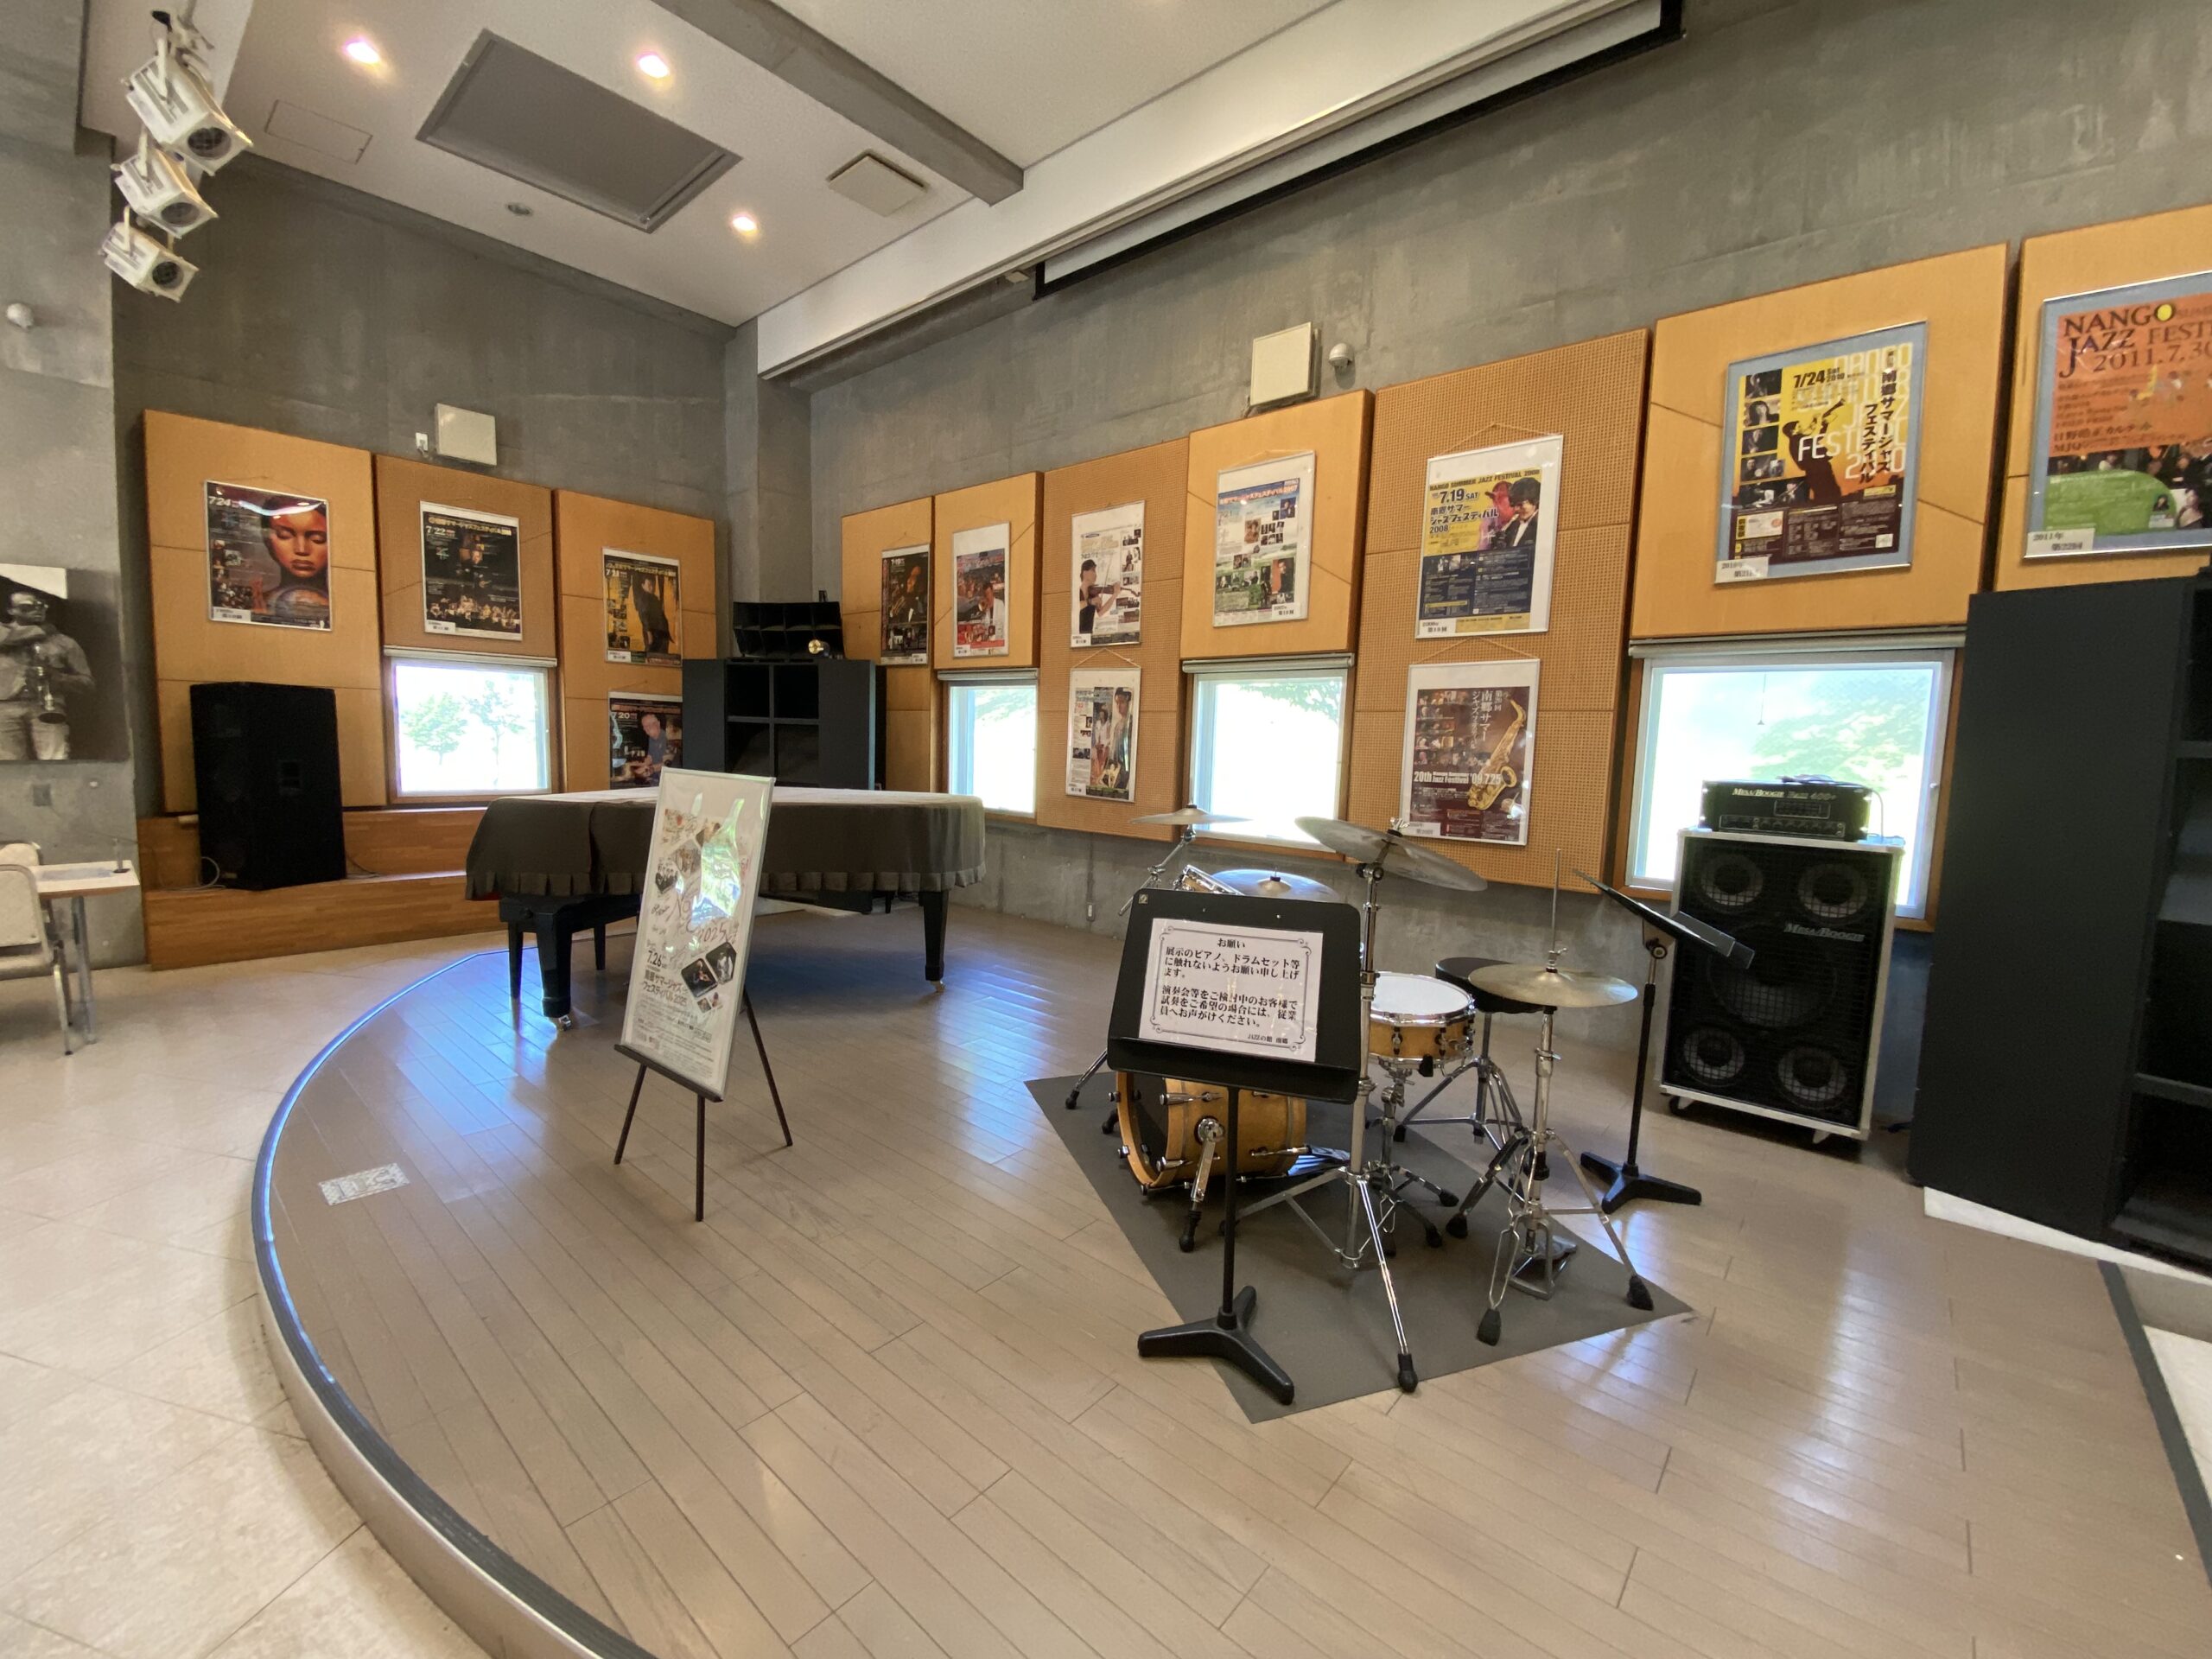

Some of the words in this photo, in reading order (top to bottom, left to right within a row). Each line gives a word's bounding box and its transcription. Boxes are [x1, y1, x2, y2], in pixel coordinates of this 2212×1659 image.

[2064, 304, 2176, 336] NANGO
[2060, 328, 2136, 378] JAZZ
[1794, 370, 1826, 389] 7/24
[1859, 403, 1878, 484] フェスティバル
[1478, 475, 1492, 484] JAZZ
[1494, 471, 1522, 481] FESTIVAL
[1440, 488, 1465, 504] 7.19
[1465, 492, 1479, 500] SAT
[1430, 525, 1448, 534] 2008
[1479, 690, 1493, 741] 南郷サマー
[1414, 771, 1432, 782] 20th
[1217, 938, 1246, 949] お願い
[647, 950, 662, 967] 7.26
[1166, 946, 1300, 969] 展示のピアノ、ドラムセット等
[1164, 967, 1186, 979] ます。
[1165, 957, 1300, 980] に触れないようお願い申し上げ
[1160, 995, 1297, 1021] 試奏をご希望の場合には、従業
[1160, 1006, 1261, 1027] 員へお声がけください。
